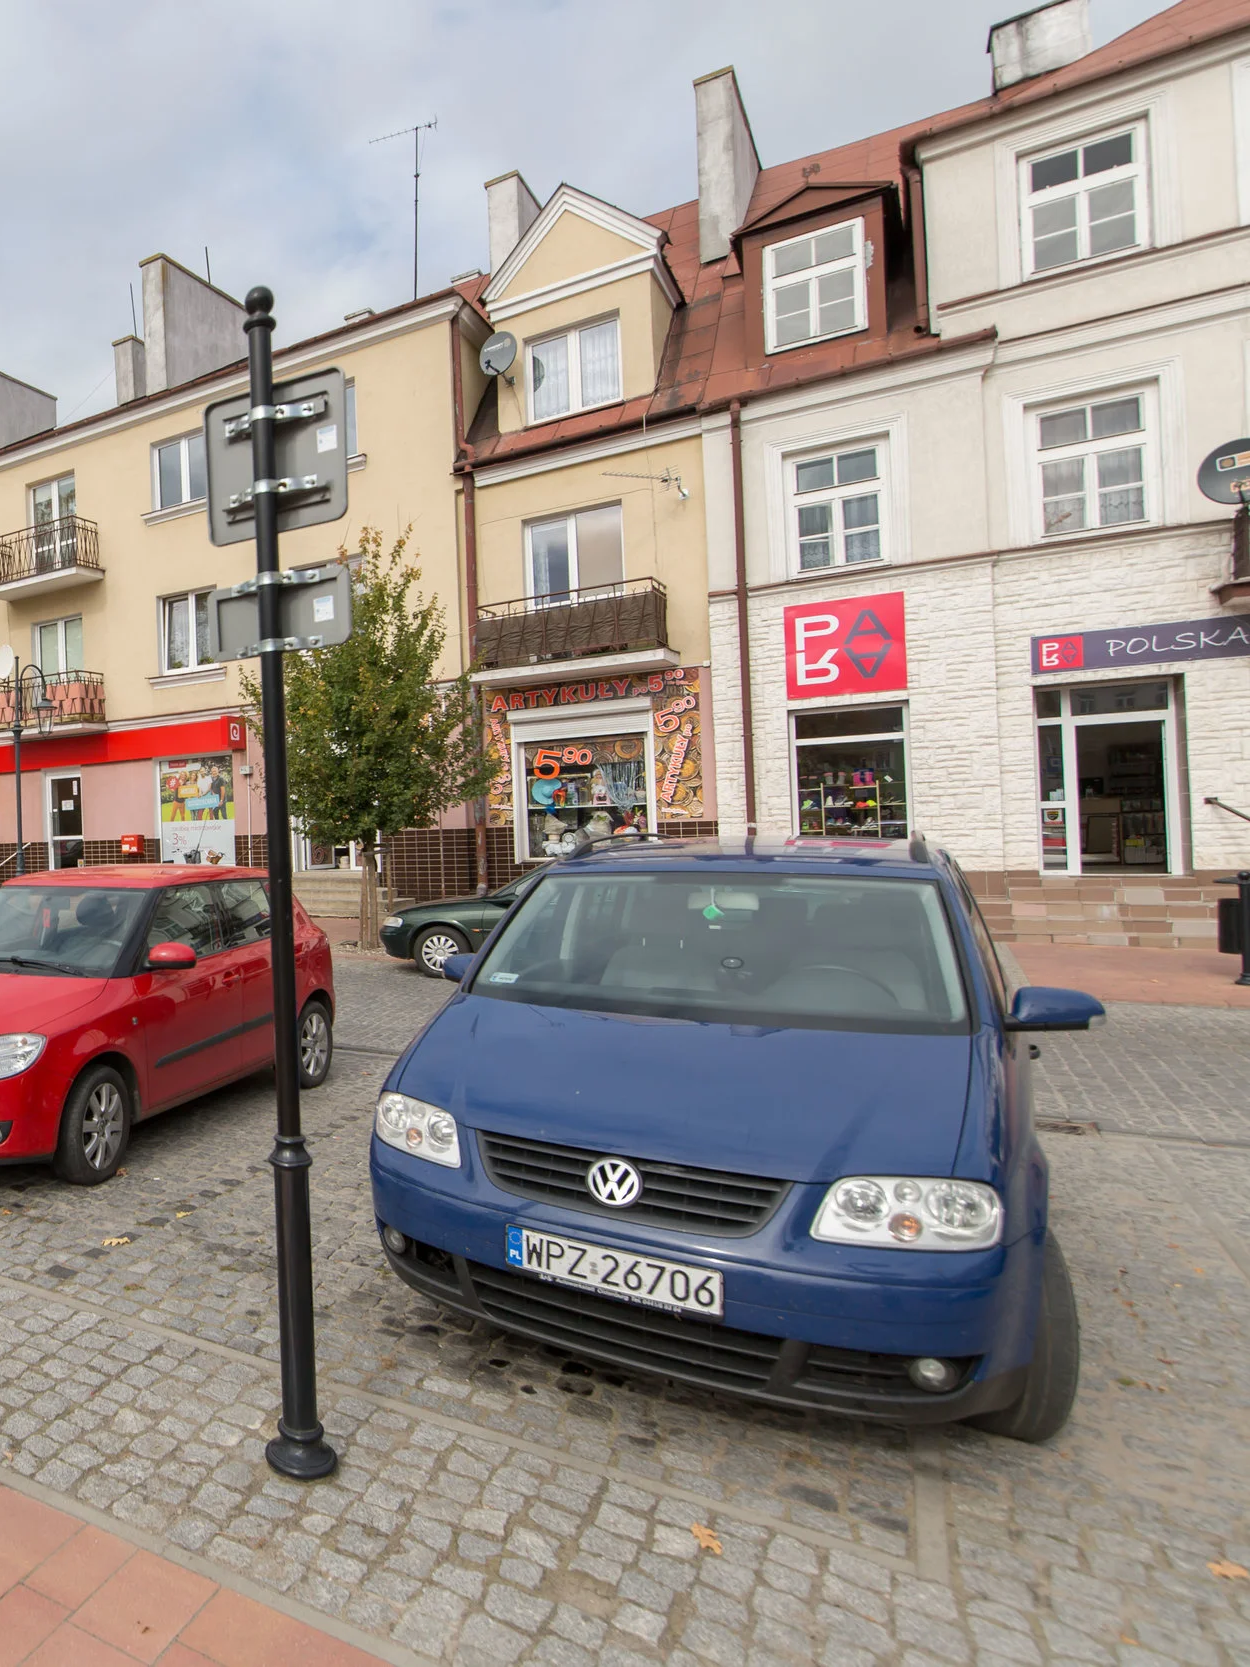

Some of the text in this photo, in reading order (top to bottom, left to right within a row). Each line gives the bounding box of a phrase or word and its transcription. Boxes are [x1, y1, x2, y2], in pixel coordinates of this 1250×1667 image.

[1105, 626, 1250, 657] POLSKA
[491, 678, 631, 712] ARTYKUŁY
[632, 686, 647, 696] po
[661, 734, 689, 803] ARTYKUŁY
[683, 723, 693, 737] po
[510, 1248, 521, 1260] PL
[526, 1234, 715, 1308] WPZ 26706
